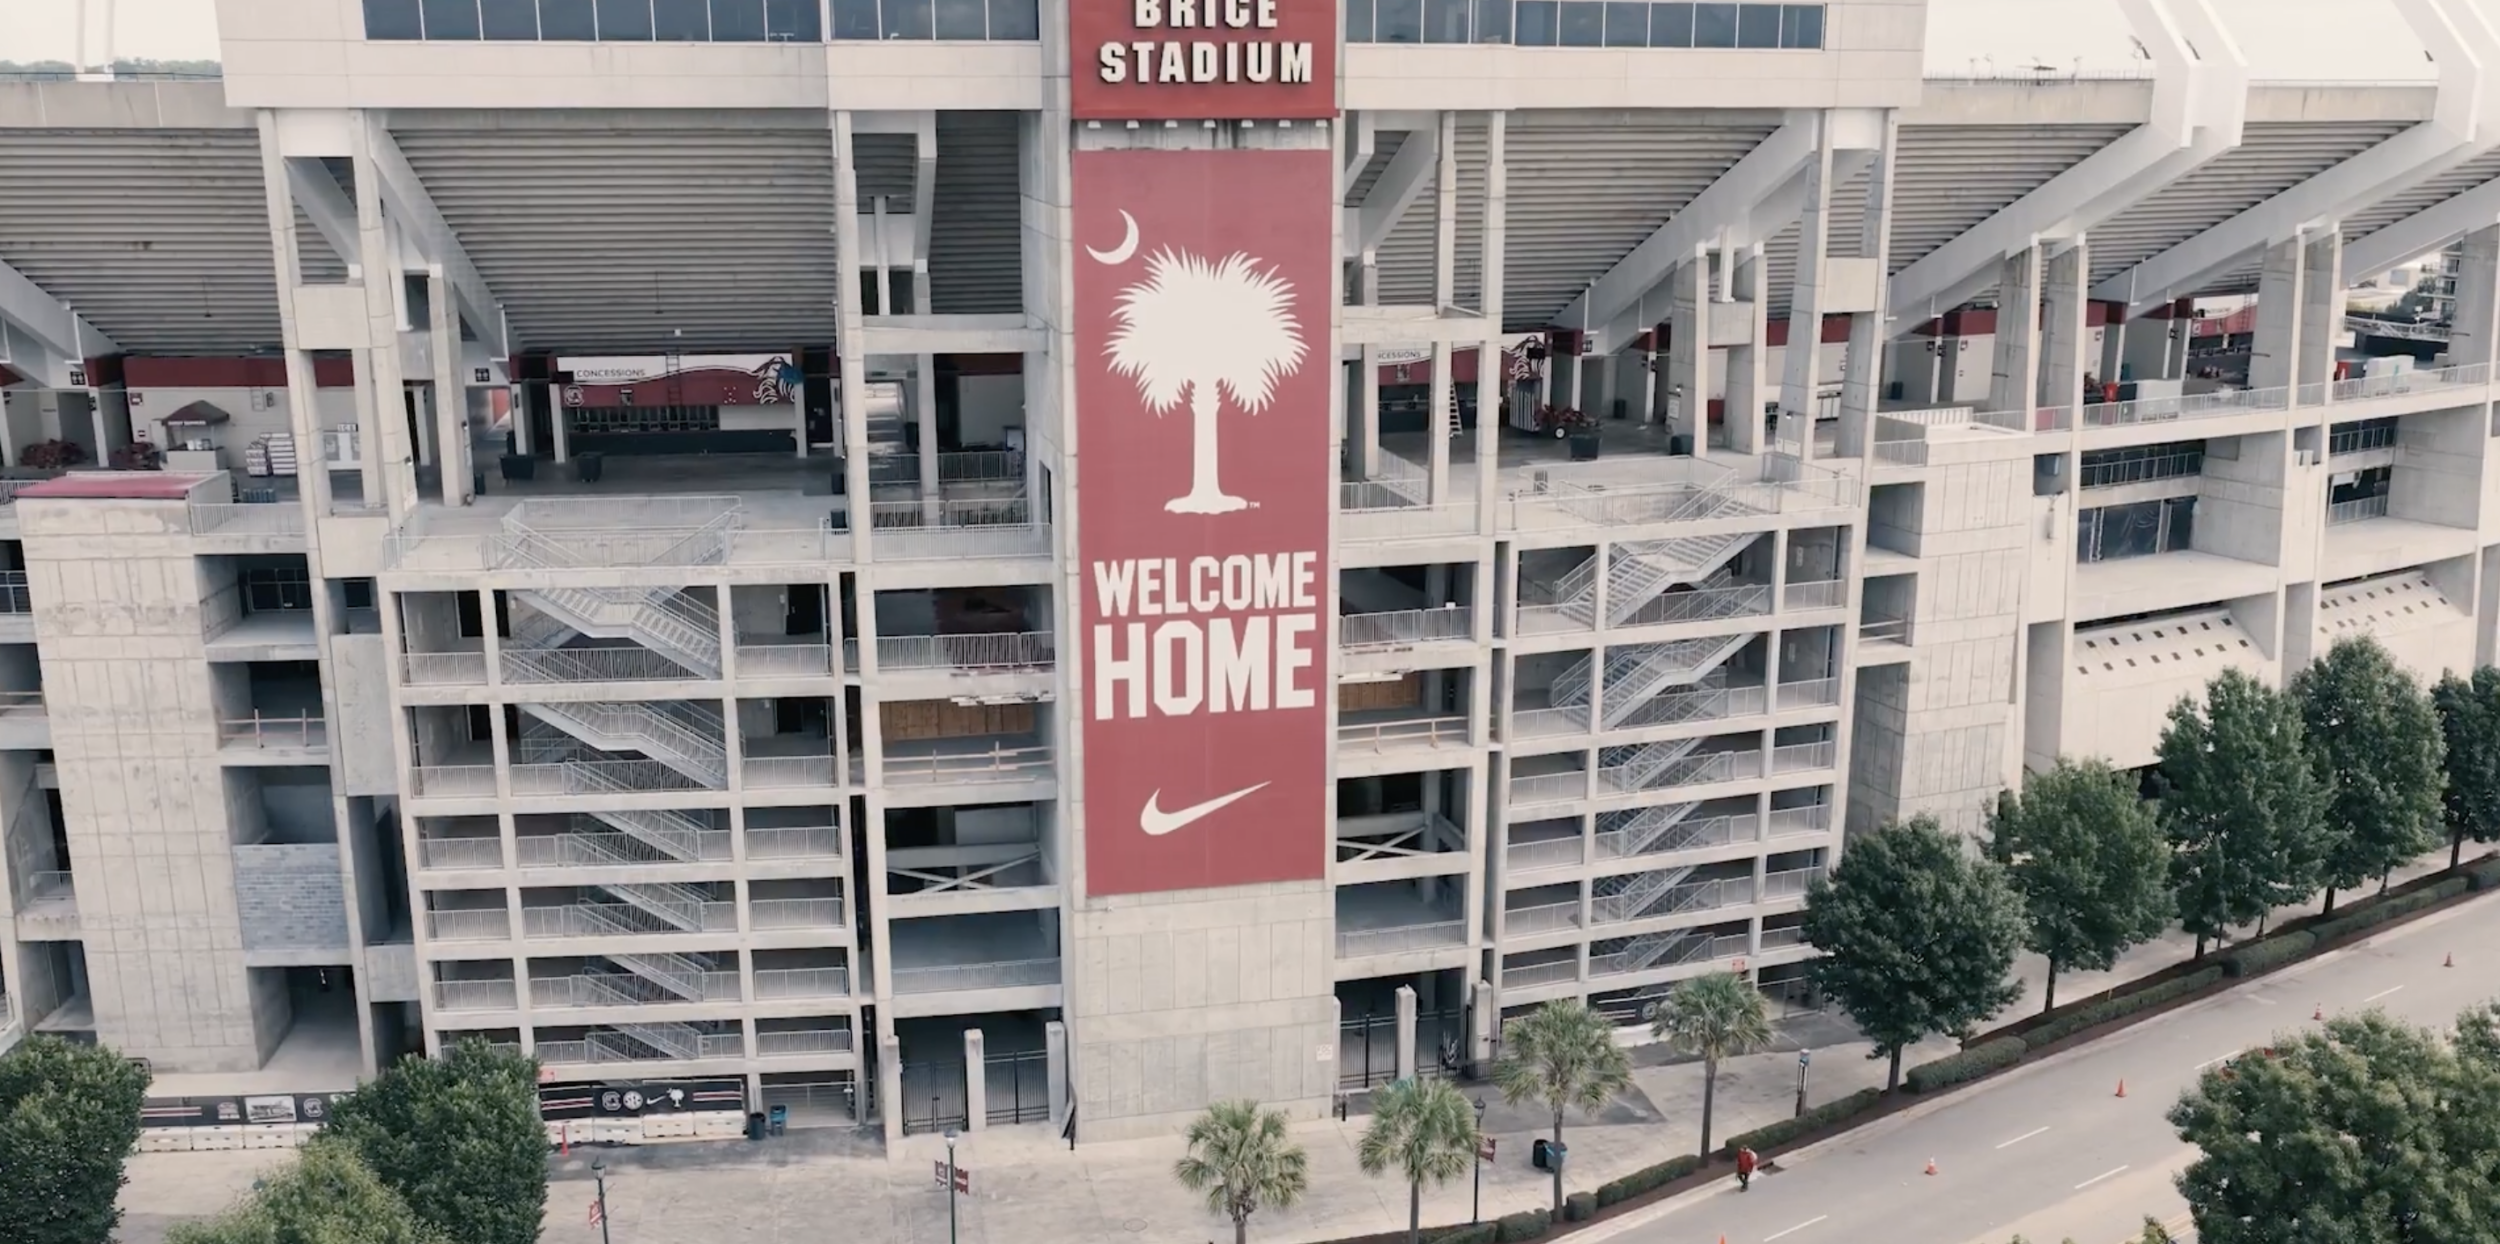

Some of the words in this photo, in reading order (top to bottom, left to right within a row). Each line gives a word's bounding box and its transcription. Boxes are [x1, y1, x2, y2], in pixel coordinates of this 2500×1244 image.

[1135, 0, 1278, 28] BRICE
[1100, 41, 1313, 83] STADIUM
[576, 368, 646, 378] CONCESSIONS
[1093, 551, 1317, 618] WELCOME
[1094, 613, 1317, 721] HOME
